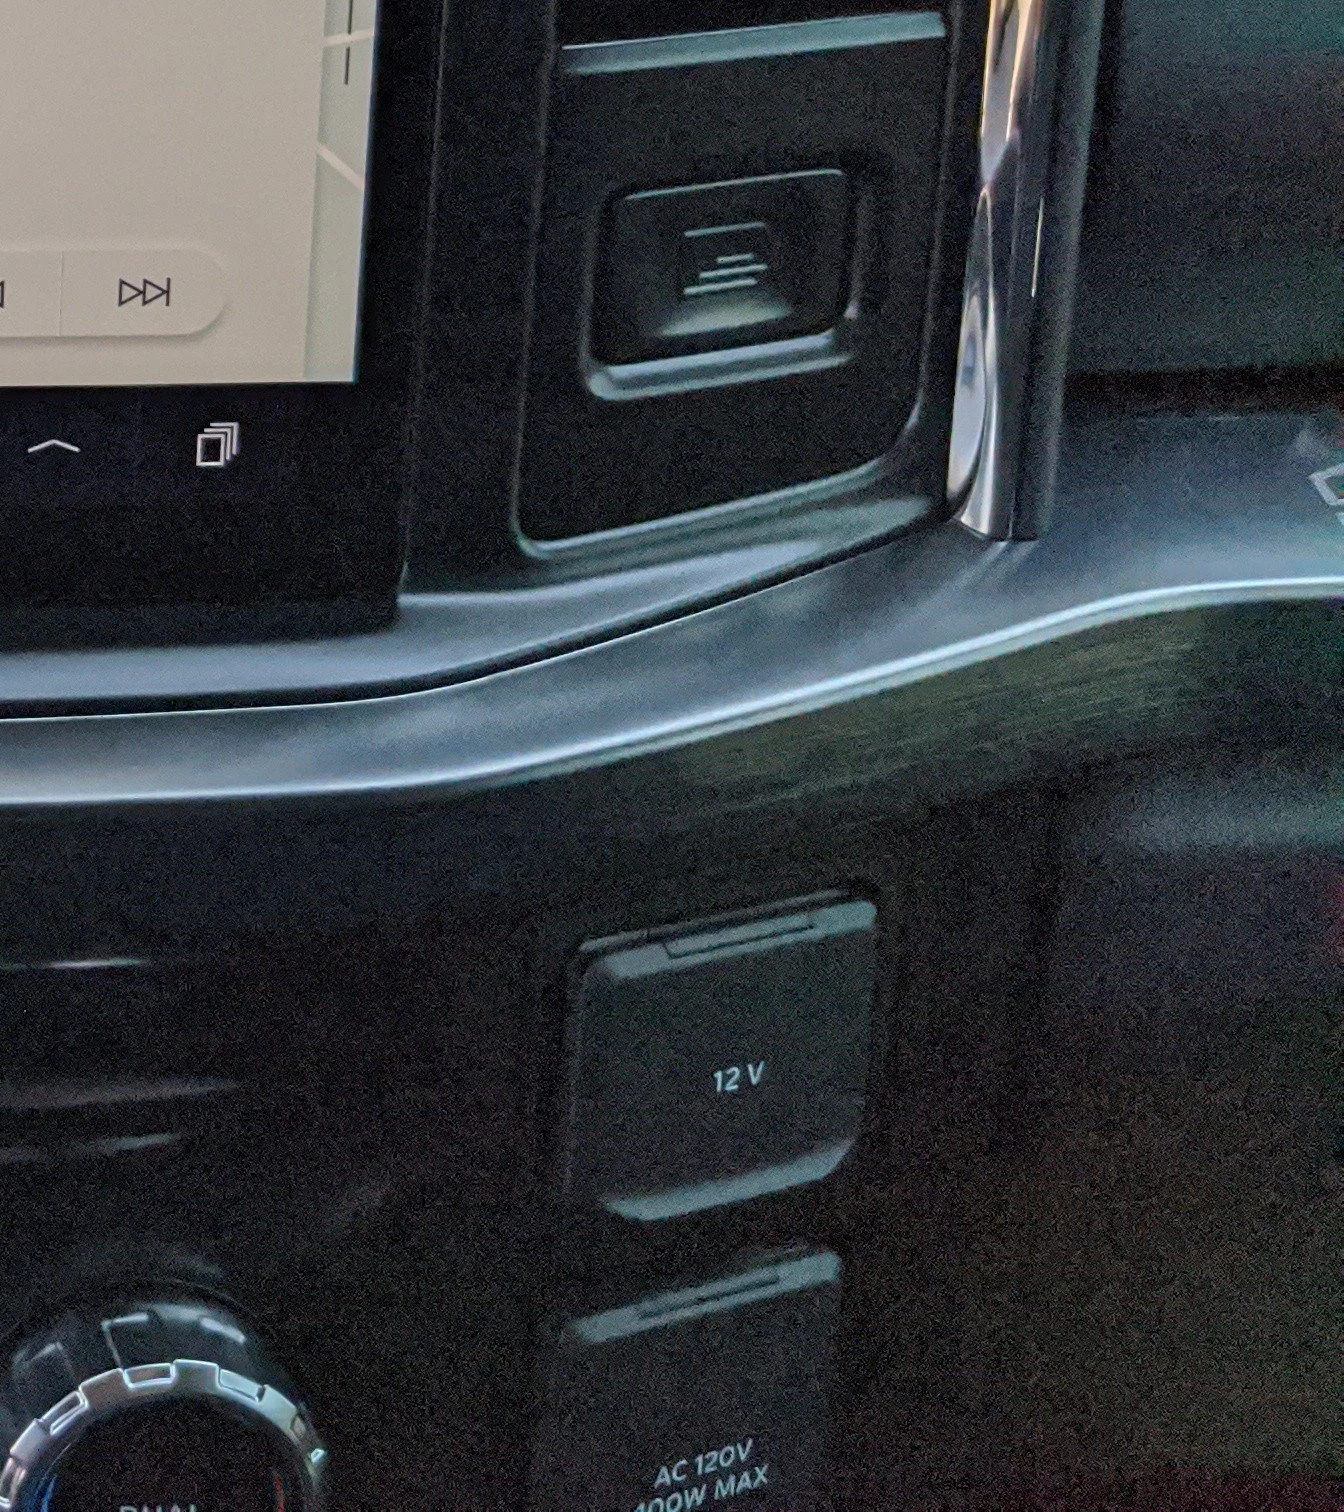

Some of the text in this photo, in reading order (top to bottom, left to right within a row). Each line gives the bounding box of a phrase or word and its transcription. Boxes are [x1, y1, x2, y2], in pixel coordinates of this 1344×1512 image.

[714, 1060, 765, 1093] 12 V
[653, 1437, 754, 1489] AC 120V
[713, 1462, 770, 1501] MAX
